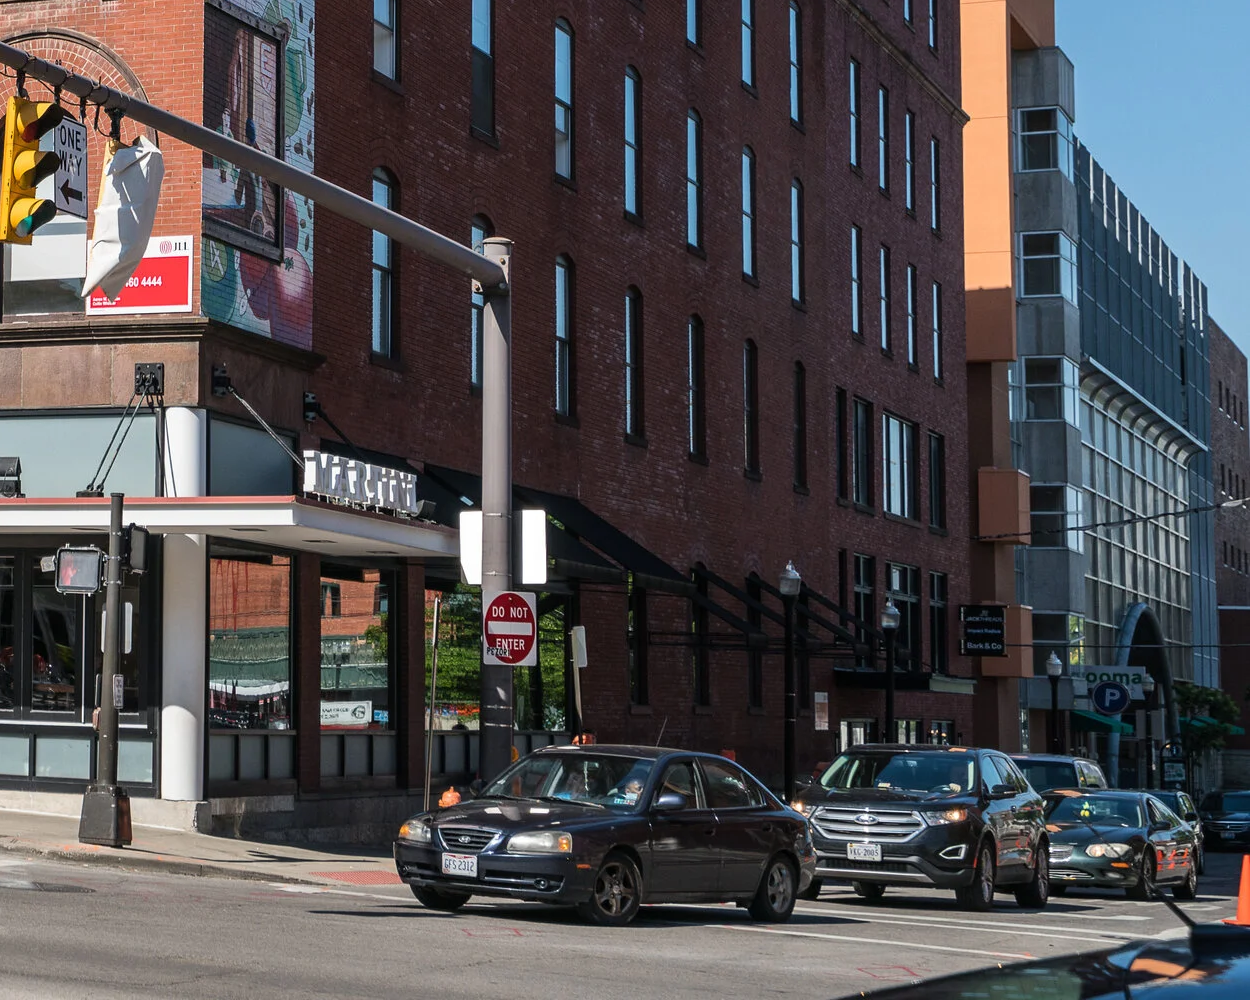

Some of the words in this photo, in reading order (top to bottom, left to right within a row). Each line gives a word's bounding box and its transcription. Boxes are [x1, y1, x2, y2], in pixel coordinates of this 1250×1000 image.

[60, 125, 82, 152] ONE
[59, 149, 83, 177] WAY
[125, 277, 139, 288] 60
[140, 276, 162, 287] 4444
[302, 449, 418, 514] MARTINI
[492, 606, 505, 618] DO
[510, 607, 529, 619] NOT
[495, 638, 526, 651] ENTER
[1104, 688, 1121, 708] P
[458, 861, 474, 872] 2312
